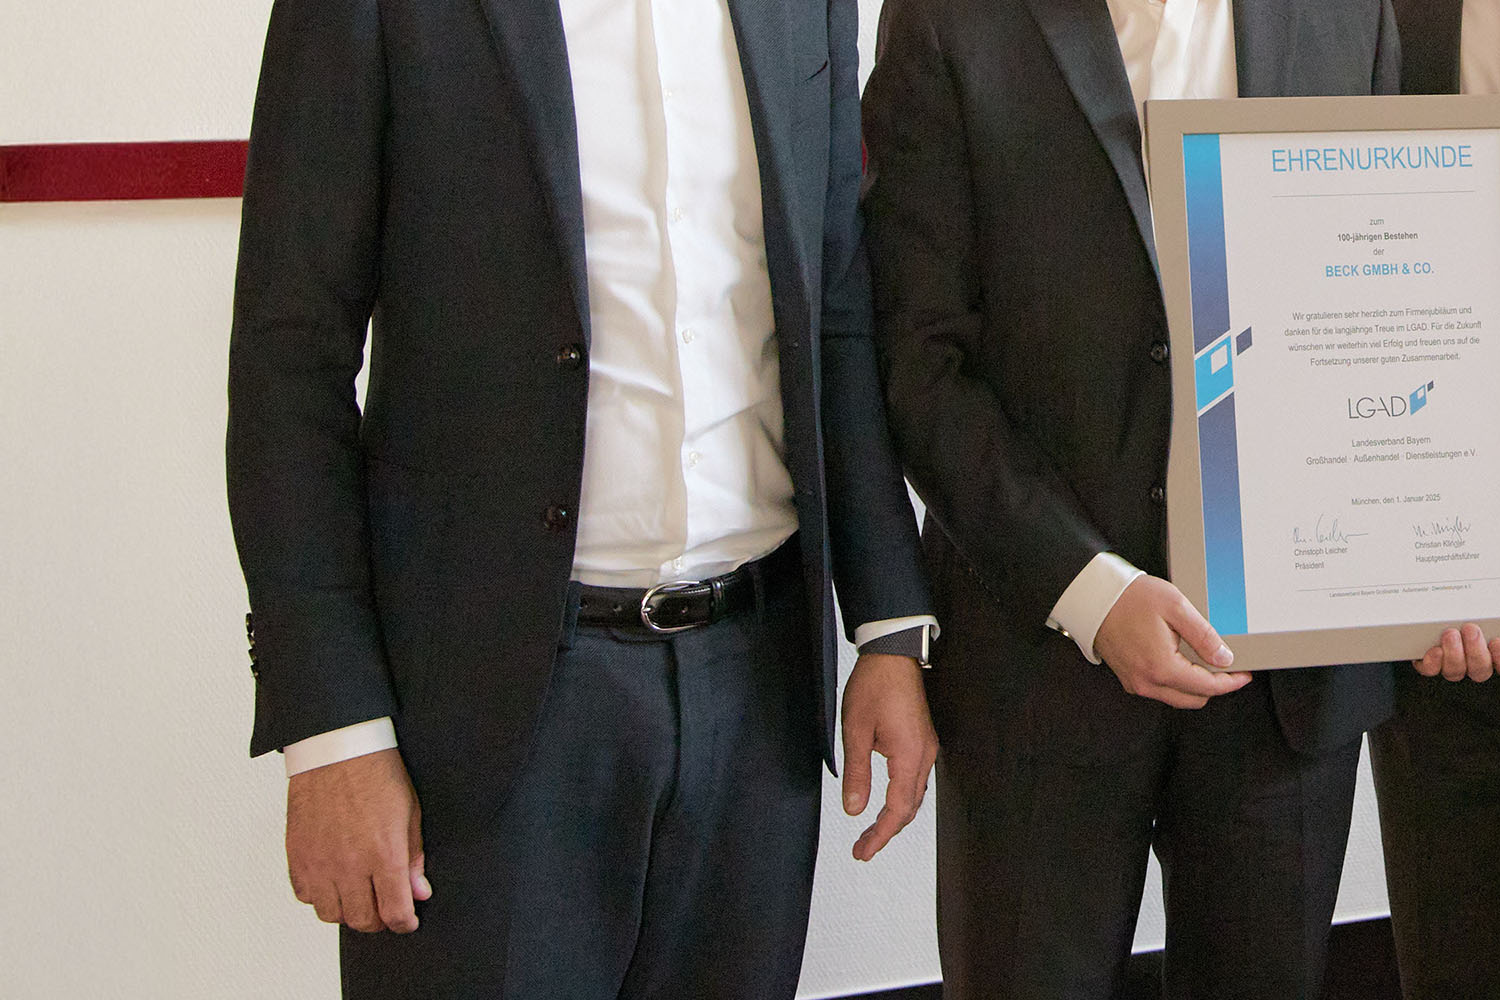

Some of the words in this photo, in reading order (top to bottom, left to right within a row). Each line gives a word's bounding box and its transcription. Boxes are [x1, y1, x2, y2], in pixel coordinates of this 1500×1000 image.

[1272, 145, 1473, 172] EHRENURKUNDE
[1338, 233, 1382, 243] 100-jährigen
[1384, 232, 1418, 240] Bestehen
[1326, 265, 1359, 277] BECK
[1363, 264, 1398, 275] GMBH
[1402, 263, 1410, 274] &
[1414, 262, 1435, 274] CO.
[1292, 312, 1305, 320] Wir
[1361, 309, 1388, 317] herzlich
[1459, 306, 1472, 314] und
[1284, 328, 1310, 336] danken
[1431, 322, 1442, 330] Für
[1456, 321, 1481, 329] Zukunft
[1288, 343, 1323, 351] wünschen
[1383, 339, 1403, 349] Erfolg
[1457, 336, 1468, 344] auf
[1310, 358, 1351, 366] Fortsetzung
[1381, 356, 1400, 365] guten
[1348, 396, 1406, 419] LGAD
[1352, 437, 1405, 447] Landesverband
[1407, 436, 1431, 446] Bayern
[1306, 456, 1347, 465] Großhandel
[1354, 453, 1399, 462] Außenhandel
[1295, 560, 1324, 569] Präsident
